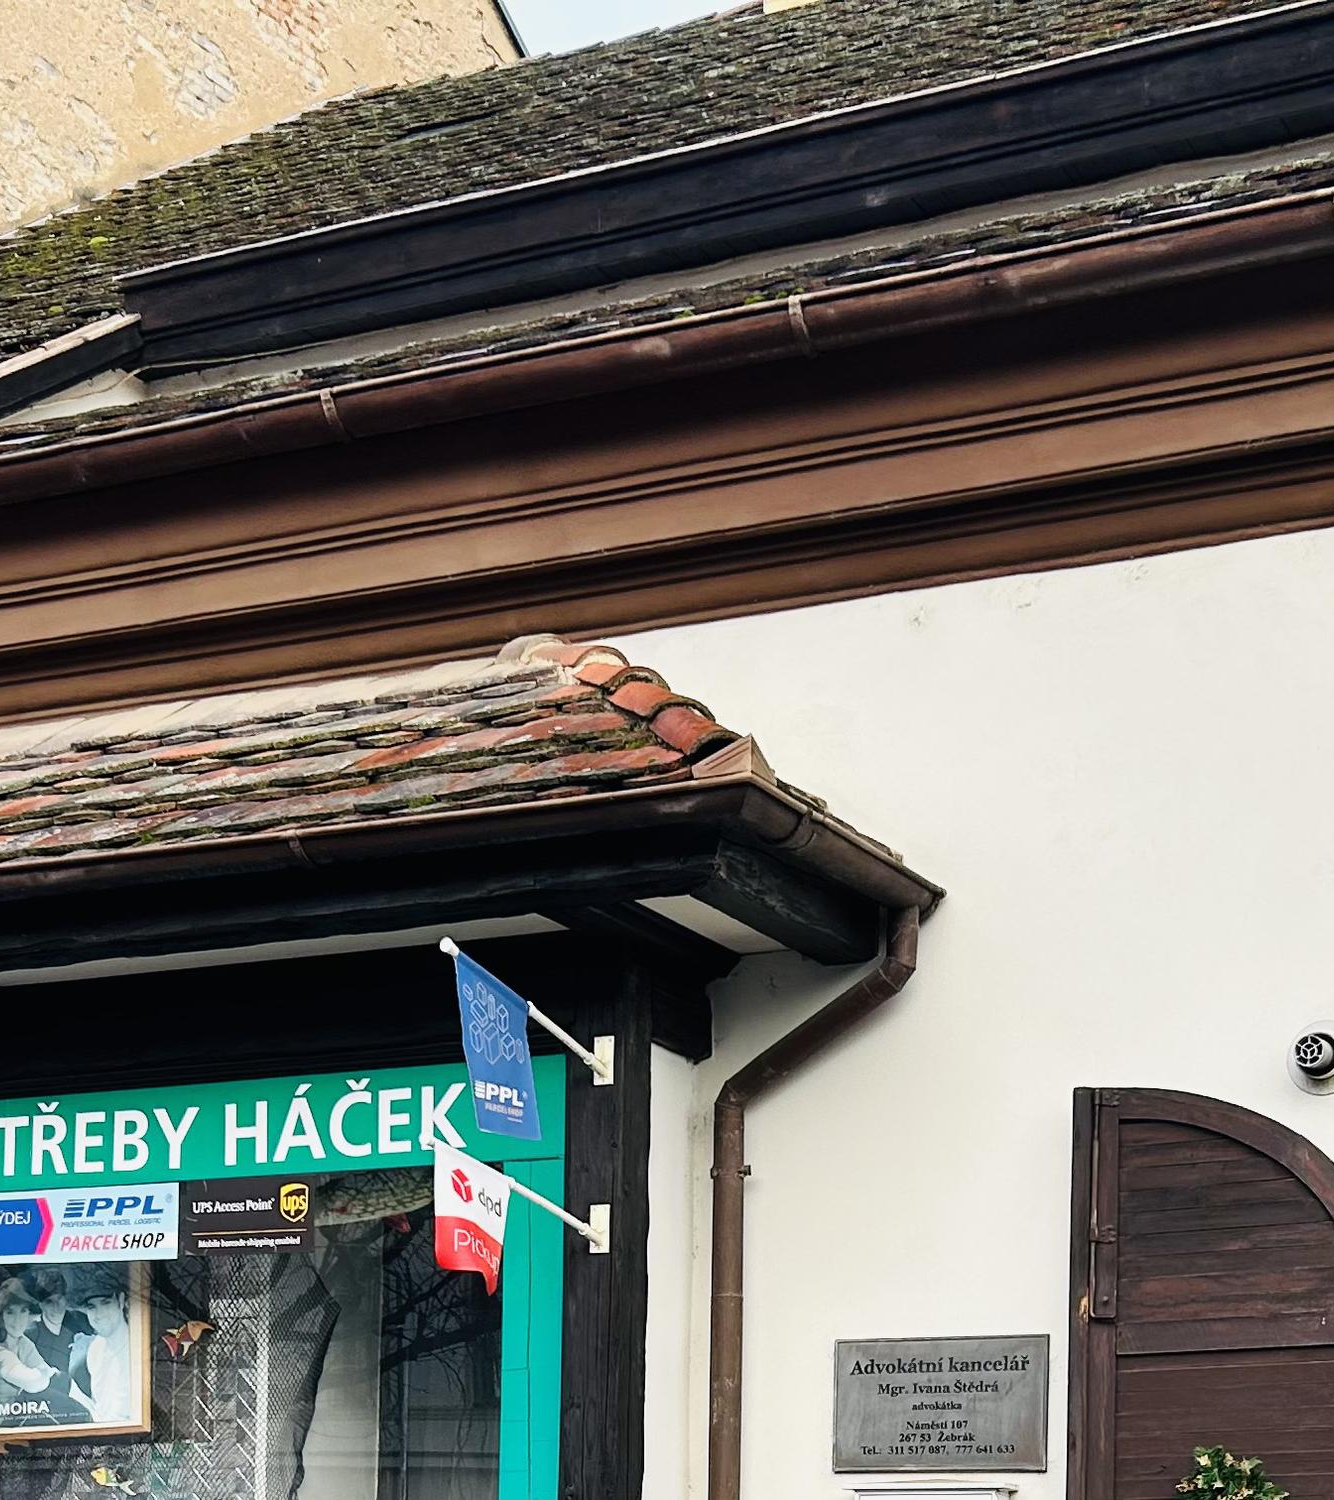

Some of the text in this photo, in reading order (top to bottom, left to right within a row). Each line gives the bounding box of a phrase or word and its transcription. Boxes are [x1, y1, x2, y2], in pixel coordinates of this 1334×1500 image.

[223, 1078, 467, 1166] HÁČEK
[86, 1195, 164, 1217] PPL
[192, 1198, 272, 1214] UPS Access Point
[282, 1194, 307, 1216] ups
[478, 1187, 502, 1217] dpd
[59, 1232, 165, 1252] PARCELSHOP
[849, 1354, 1030, 1376] Advokátní kancelář
[877, 1379, 999, 1397] Mgr. Ivana Štědrá
[911, 1400, 962, 1411] advokátka
[906, 1420, 968, 1431] Náměstí 107
[899, 1430, 975, 1443] 267 53 Žebrák
[887, 1445, 905, 1455] 311
[908, 1445, 925, 1456] 517
[955, 1444, 973, 1454] 777
[975, 1444, 993, 1454] 641
[996, 1444, 1015, 1454] 633
